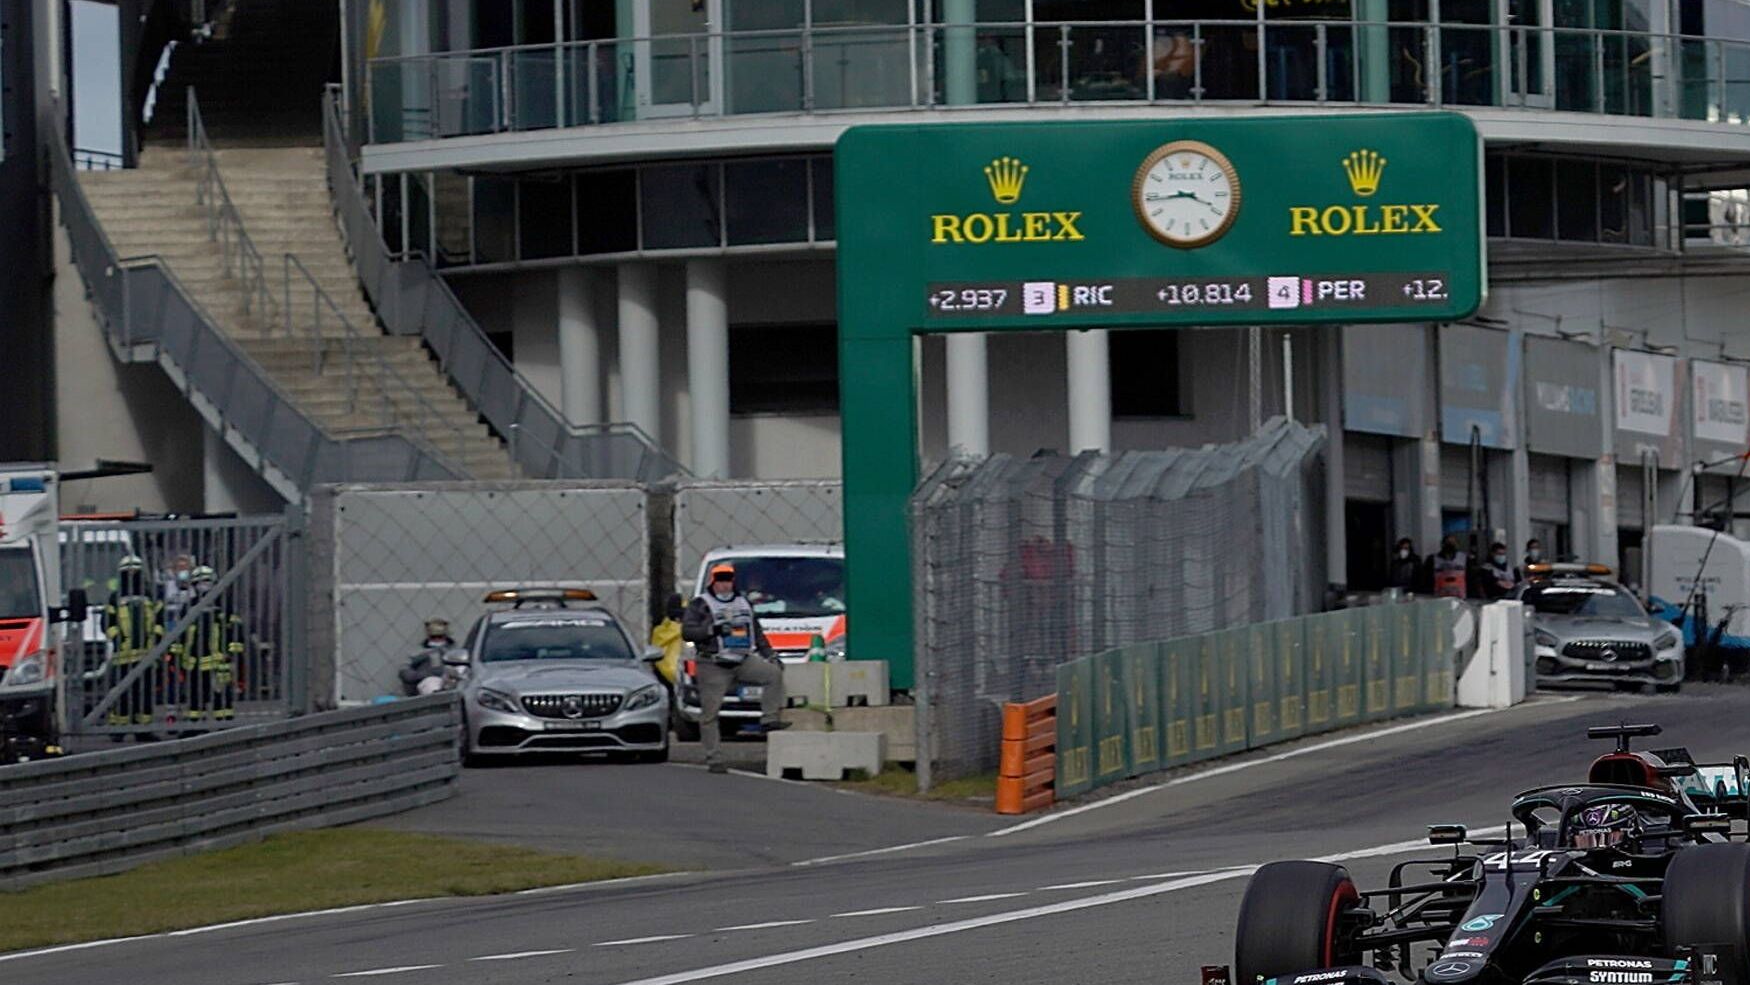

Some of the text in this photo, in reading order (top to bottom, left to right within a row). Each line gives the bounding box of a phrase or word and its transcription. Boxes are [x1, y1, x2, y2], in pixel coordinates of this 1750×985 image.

[931, 212, 1085, 244] ROLEX
[1289, 204, 1442, 237] ROLEX
[928, 288, 1008, 312] +2.937
[1073, 285, 1114, 307] RIC
[1157, 282, 1253, 305] +10.814
[1318, 280, 1367, 302] PER
[1402, 278, 1449, 300] +12.
[1293, 969, 1349, 985] PETRONAS
[1587, 958, 1652, 969] PETRONAS
